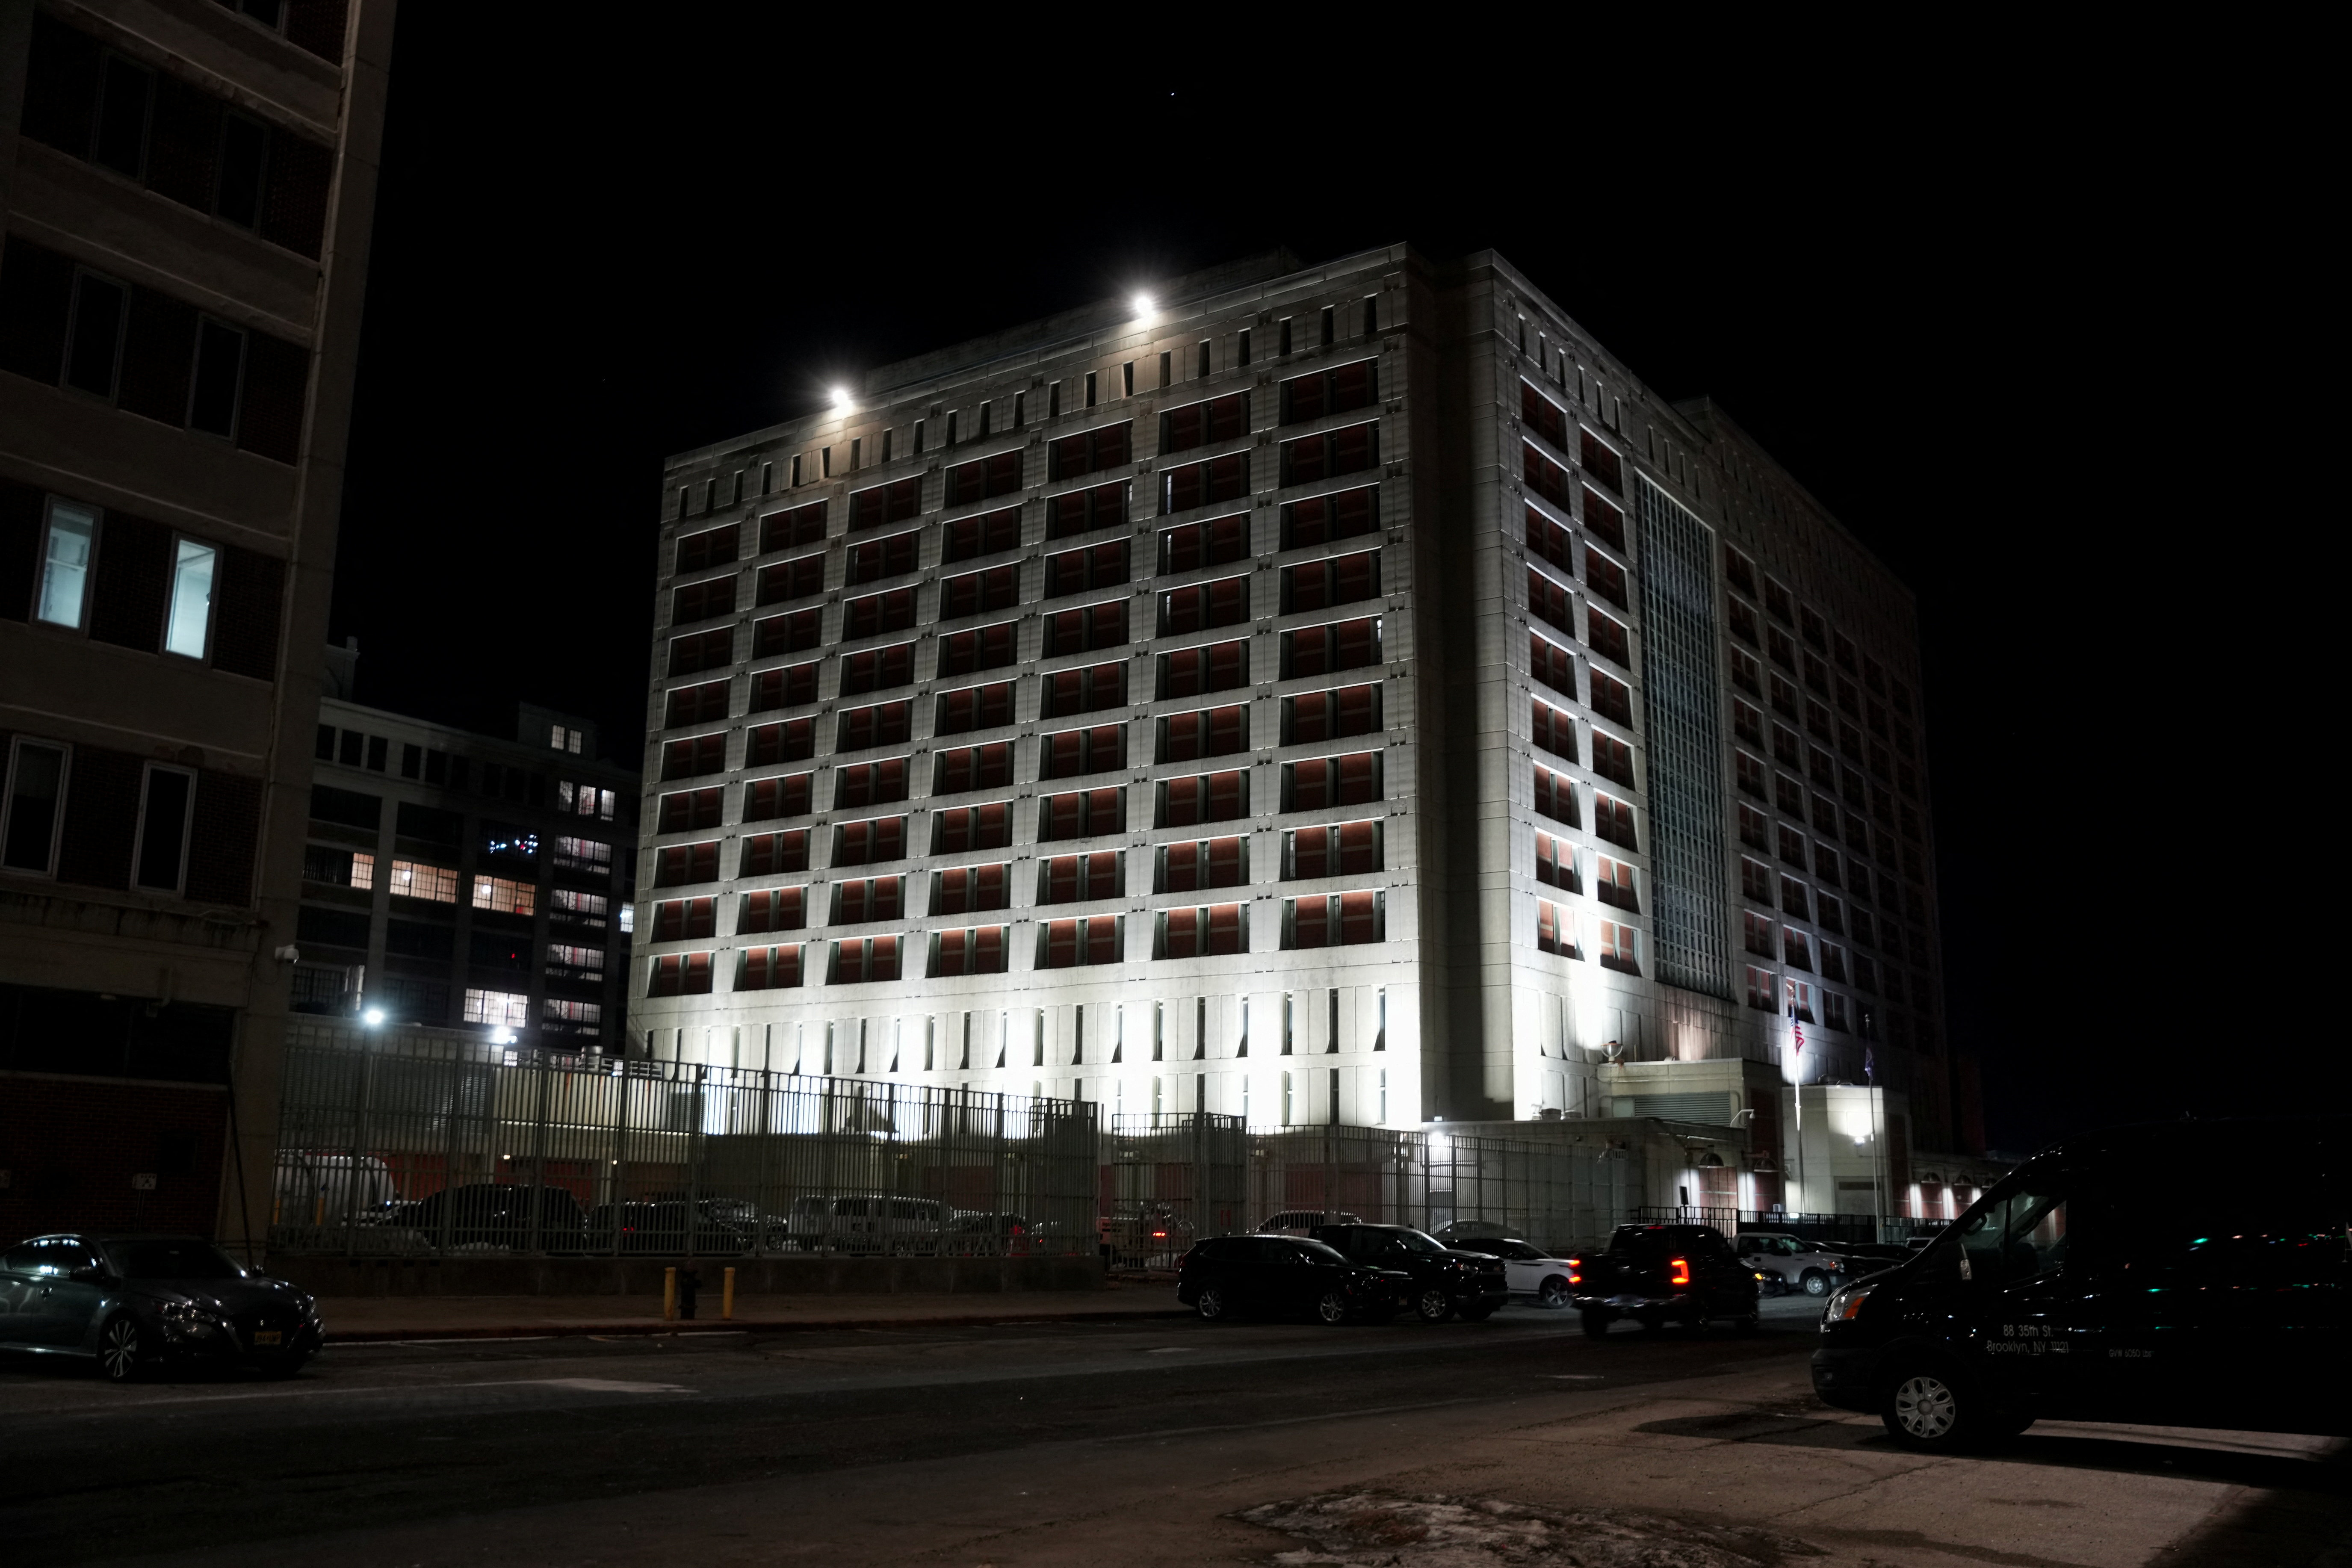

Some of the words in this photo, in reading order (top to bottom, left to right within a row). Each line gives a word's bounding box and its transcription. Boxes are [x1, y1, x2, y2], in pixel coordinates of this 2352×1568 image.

[2003, 1324, 2014, 1337] 88
[2018, 1324, 2039, 1337] 35th
[2042, 1325, 2054, 1338] St.
[1987, 1339, 2030, 1355] Brooklyn,
[2033, 1341, 2046, 1353] NY
